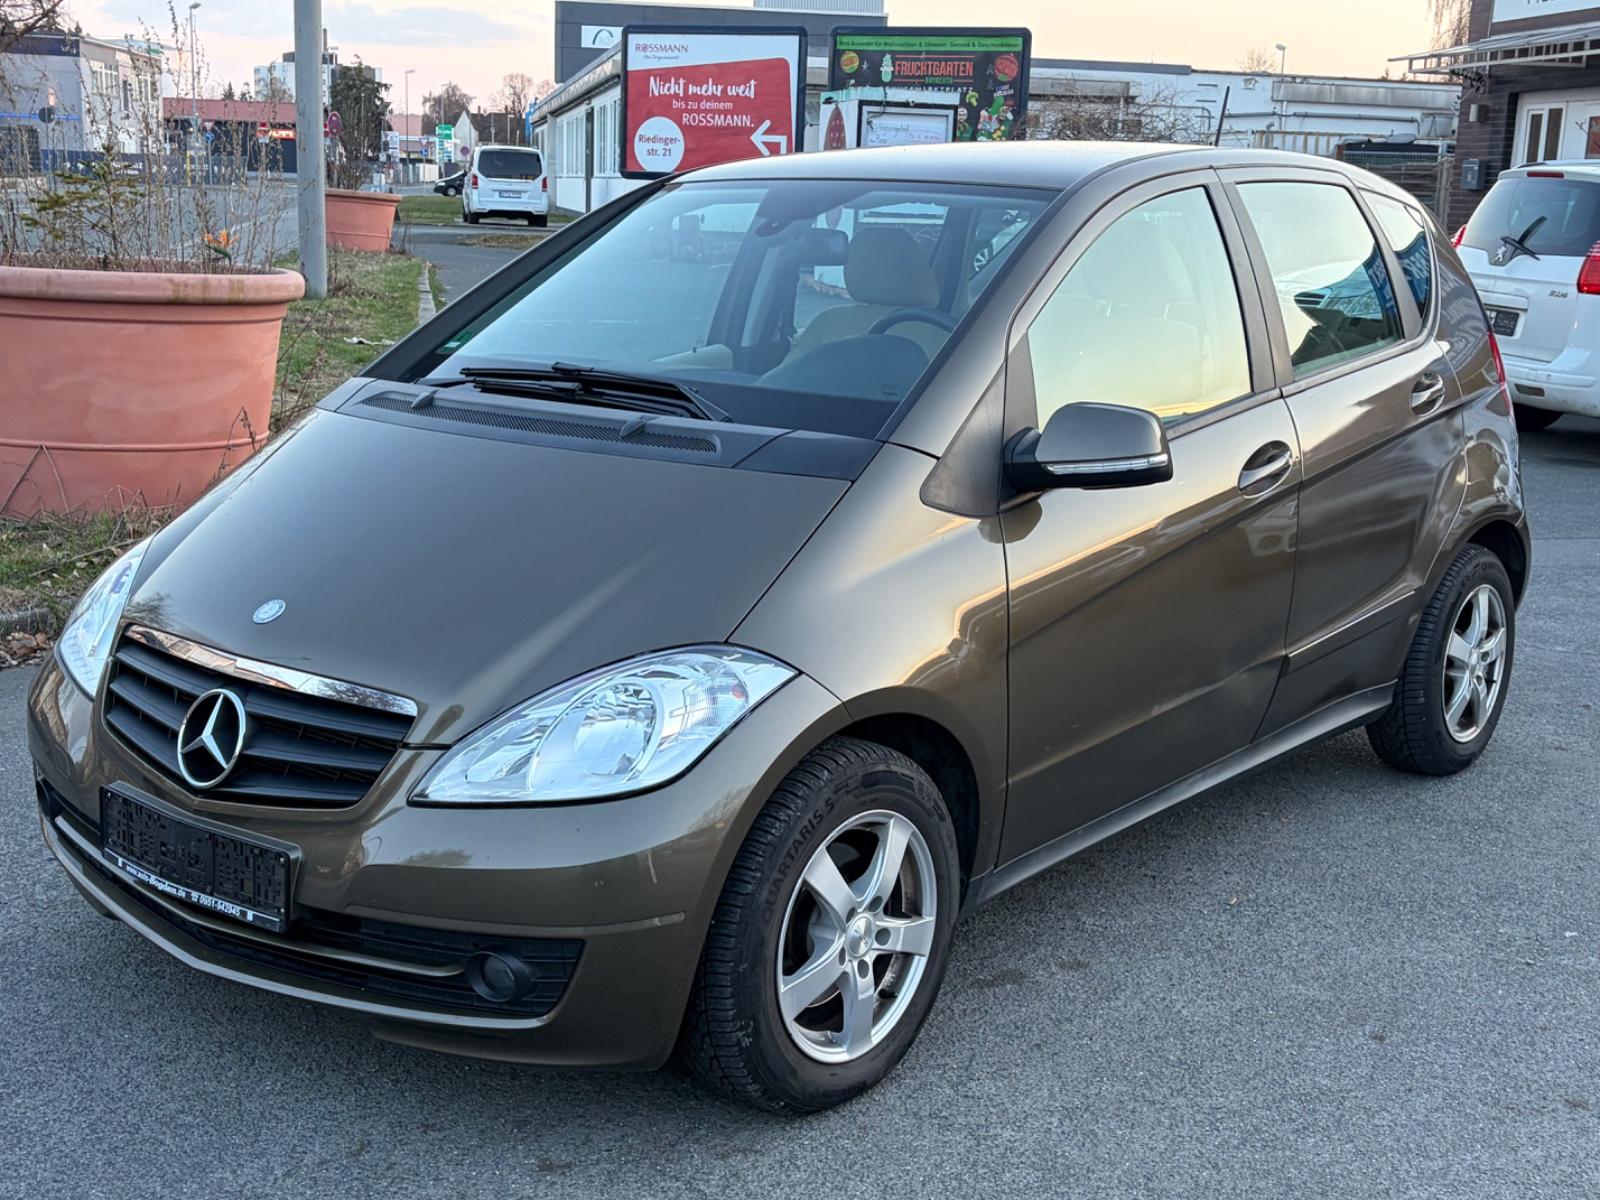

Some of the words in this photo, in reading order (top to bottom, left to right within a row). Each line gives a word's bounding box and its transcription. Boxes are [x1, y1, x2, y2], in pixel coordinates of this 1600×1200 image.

[635, 43, 688, 53] ROSSMANN
[895, 61, 974, 76] FRUCHTGARTEN
[649, 75, 687, 98] Nicht
[688, 77, 724, 97] mehr
[727, 79, 757, 99] weit
[672, 99, 686, 109] bis
[687, 101, 698, 109] zu
[699, 100, 734, 110] deinem
[682, 112, 755, 127] ROSSMANN.
[638, 134, 681, 146] Riedinger-
[646, 148, 660, 157] str.
[662, 147, 672, 157] 21
